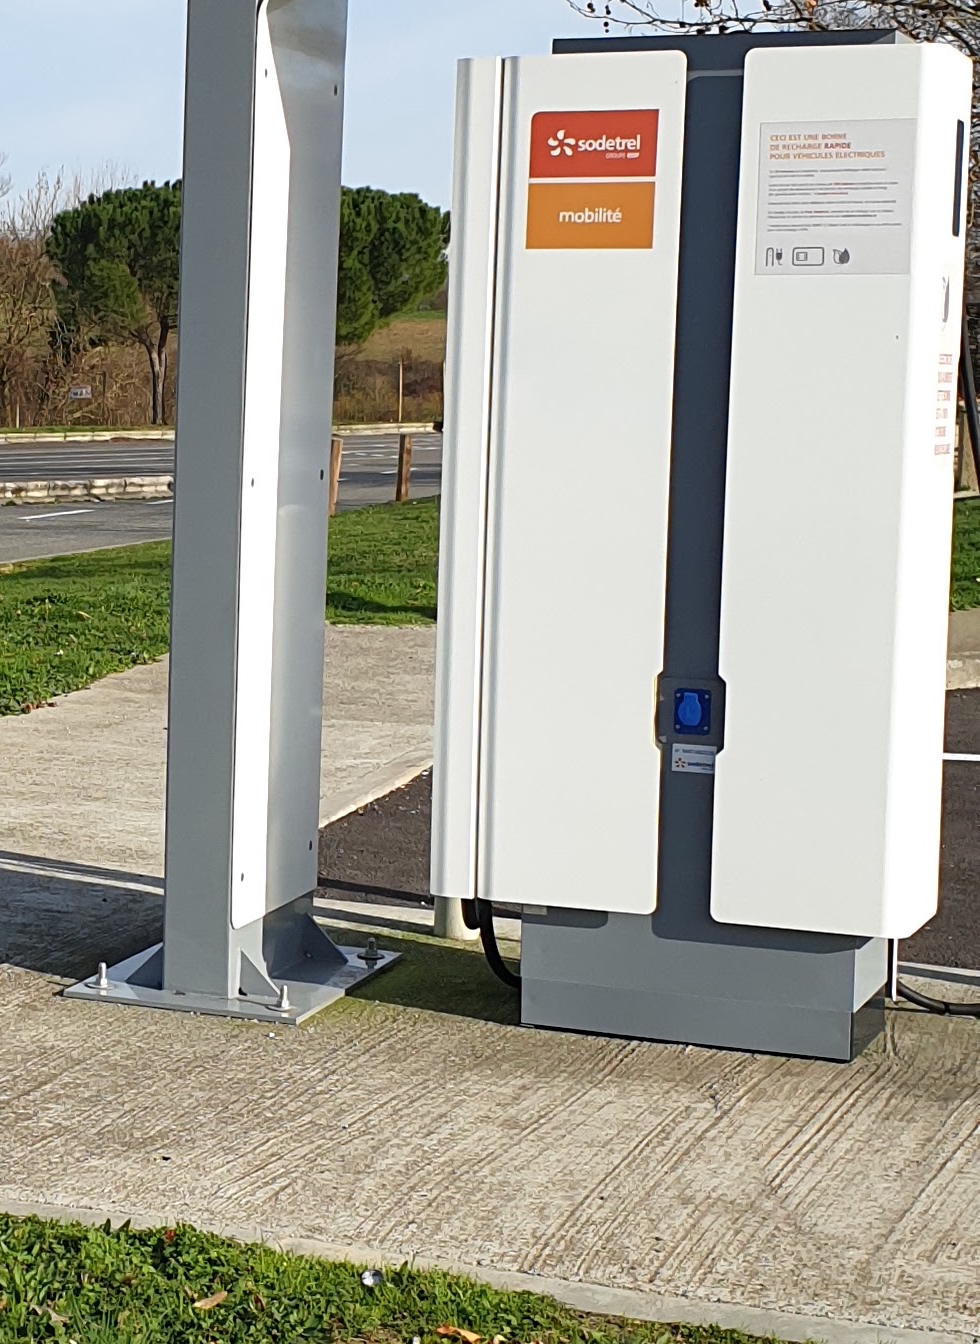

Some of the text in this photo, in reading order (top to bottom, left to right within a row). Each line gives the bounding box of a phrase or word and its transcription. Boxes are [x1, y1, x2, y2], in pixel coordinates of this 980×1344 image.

[577, 134, 641, 151] sodetrel
[769, 152, 790, 160] POUR
[559, 207, 622, 223] mobilité
